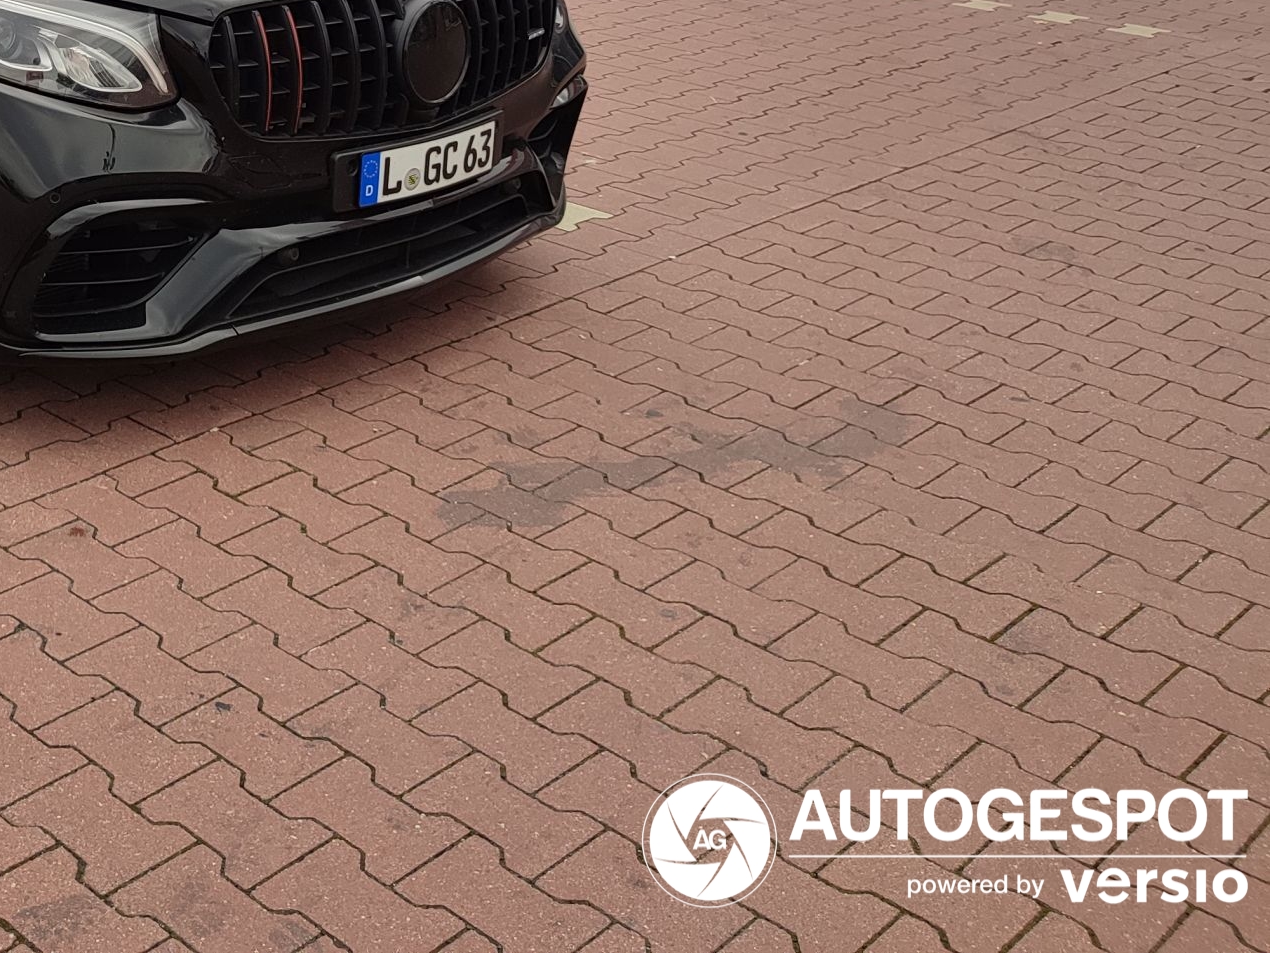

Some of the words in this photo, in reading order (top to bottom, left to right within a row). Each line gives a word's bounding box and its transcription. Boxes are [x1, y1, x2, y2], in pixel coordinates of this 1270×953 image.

[382, 156, 403, 196] L
[424, 140, 458, 186] GC
[463, 128, 492, 174] 63
[365, 184, 373, 197] D
